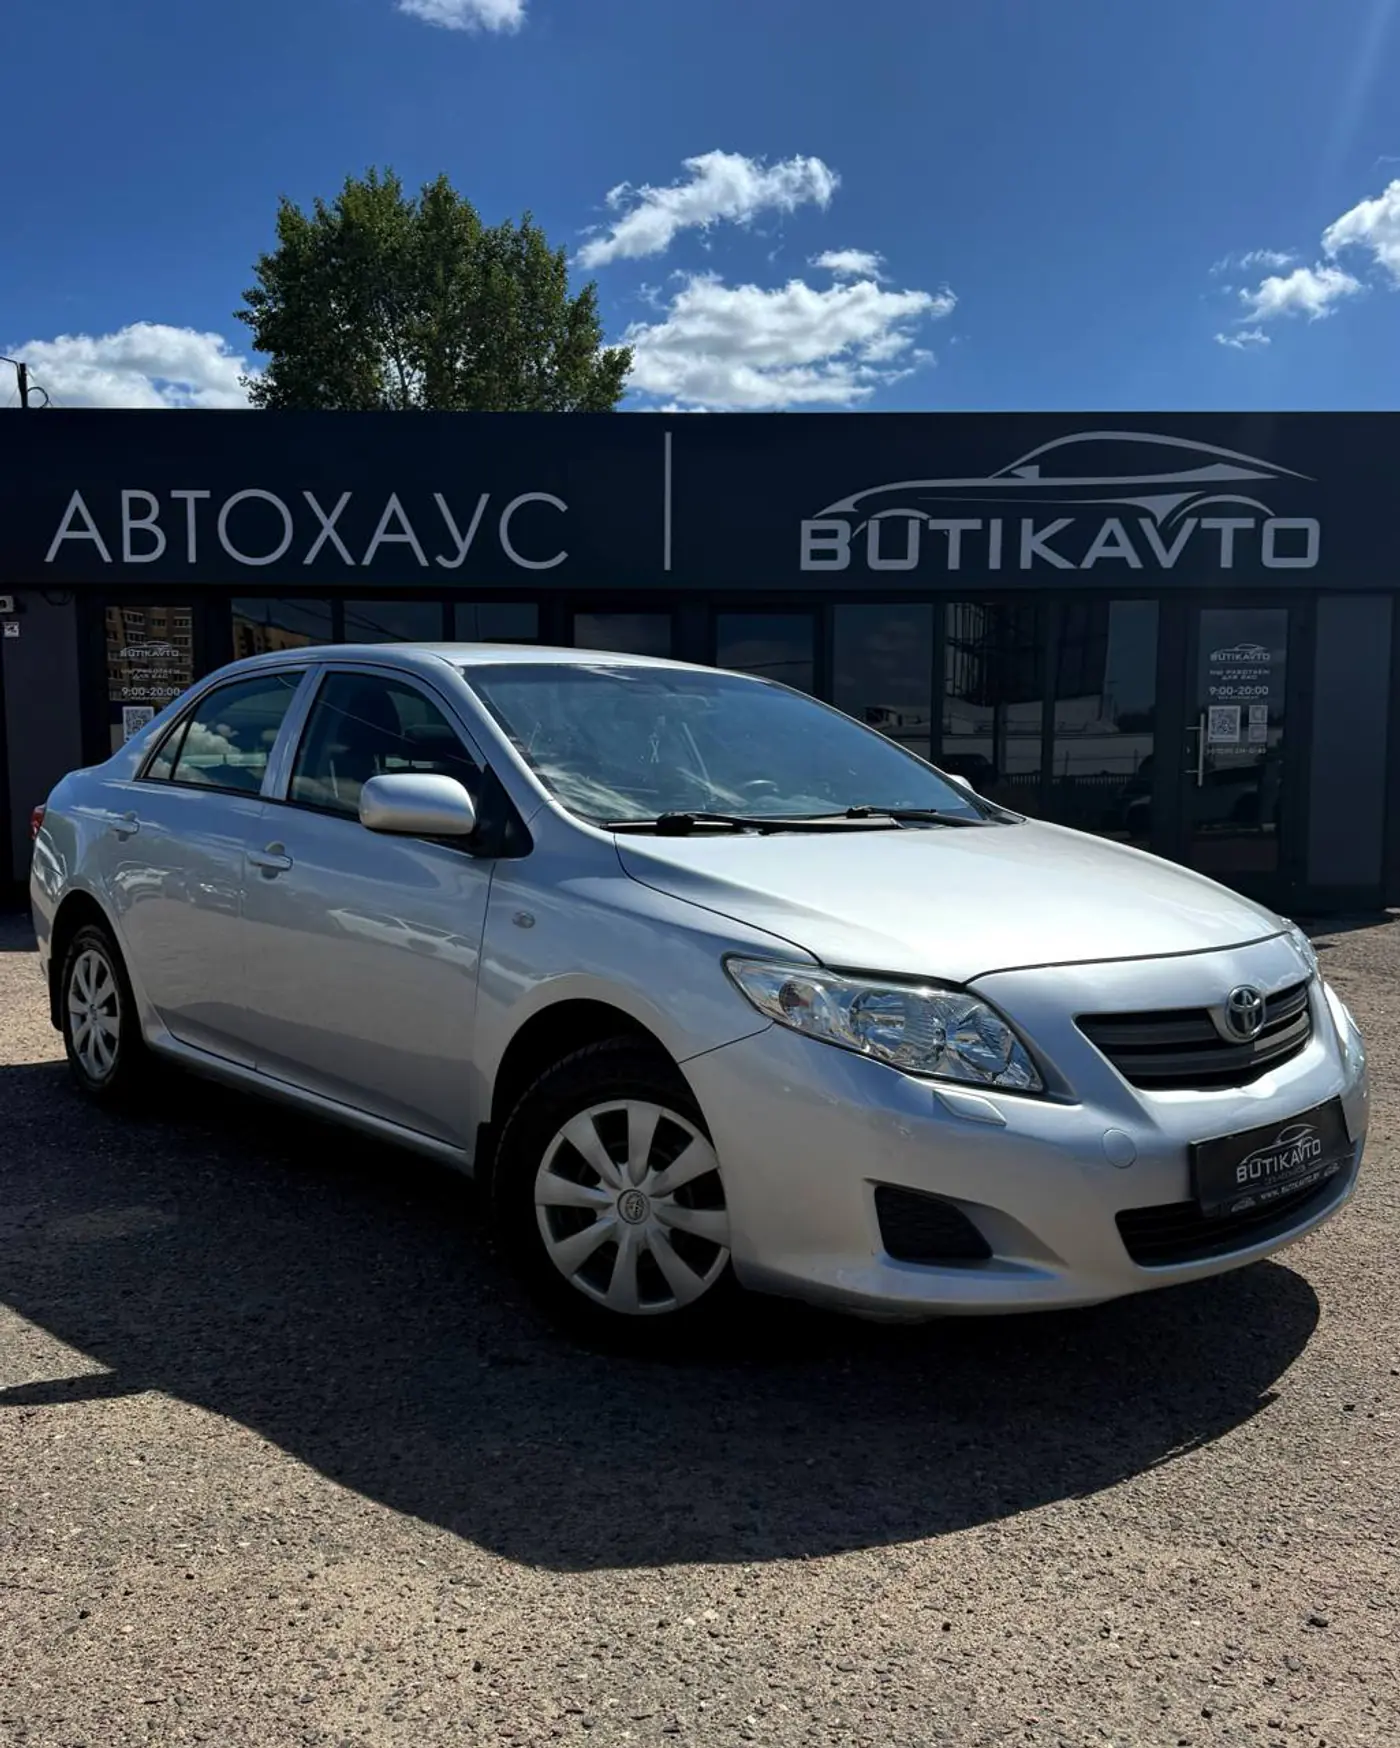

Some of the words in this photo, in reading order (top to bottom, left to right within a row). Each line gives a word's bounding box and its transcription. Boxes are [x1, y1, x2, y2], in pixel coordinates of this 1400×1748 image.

[44, 488, 570, 571] АВТОХАУС
[799, 516, 1321, 572] BUTIKAVTO
[1209, 652, 1271, 662] BUTIKAVTO
[121, 686, 181, 697] 9:00-20:00
[1209, 685, 1269, 696] 9:00-20:00
[1236, 1138, 1321, 1184] BUTIKAVTO
